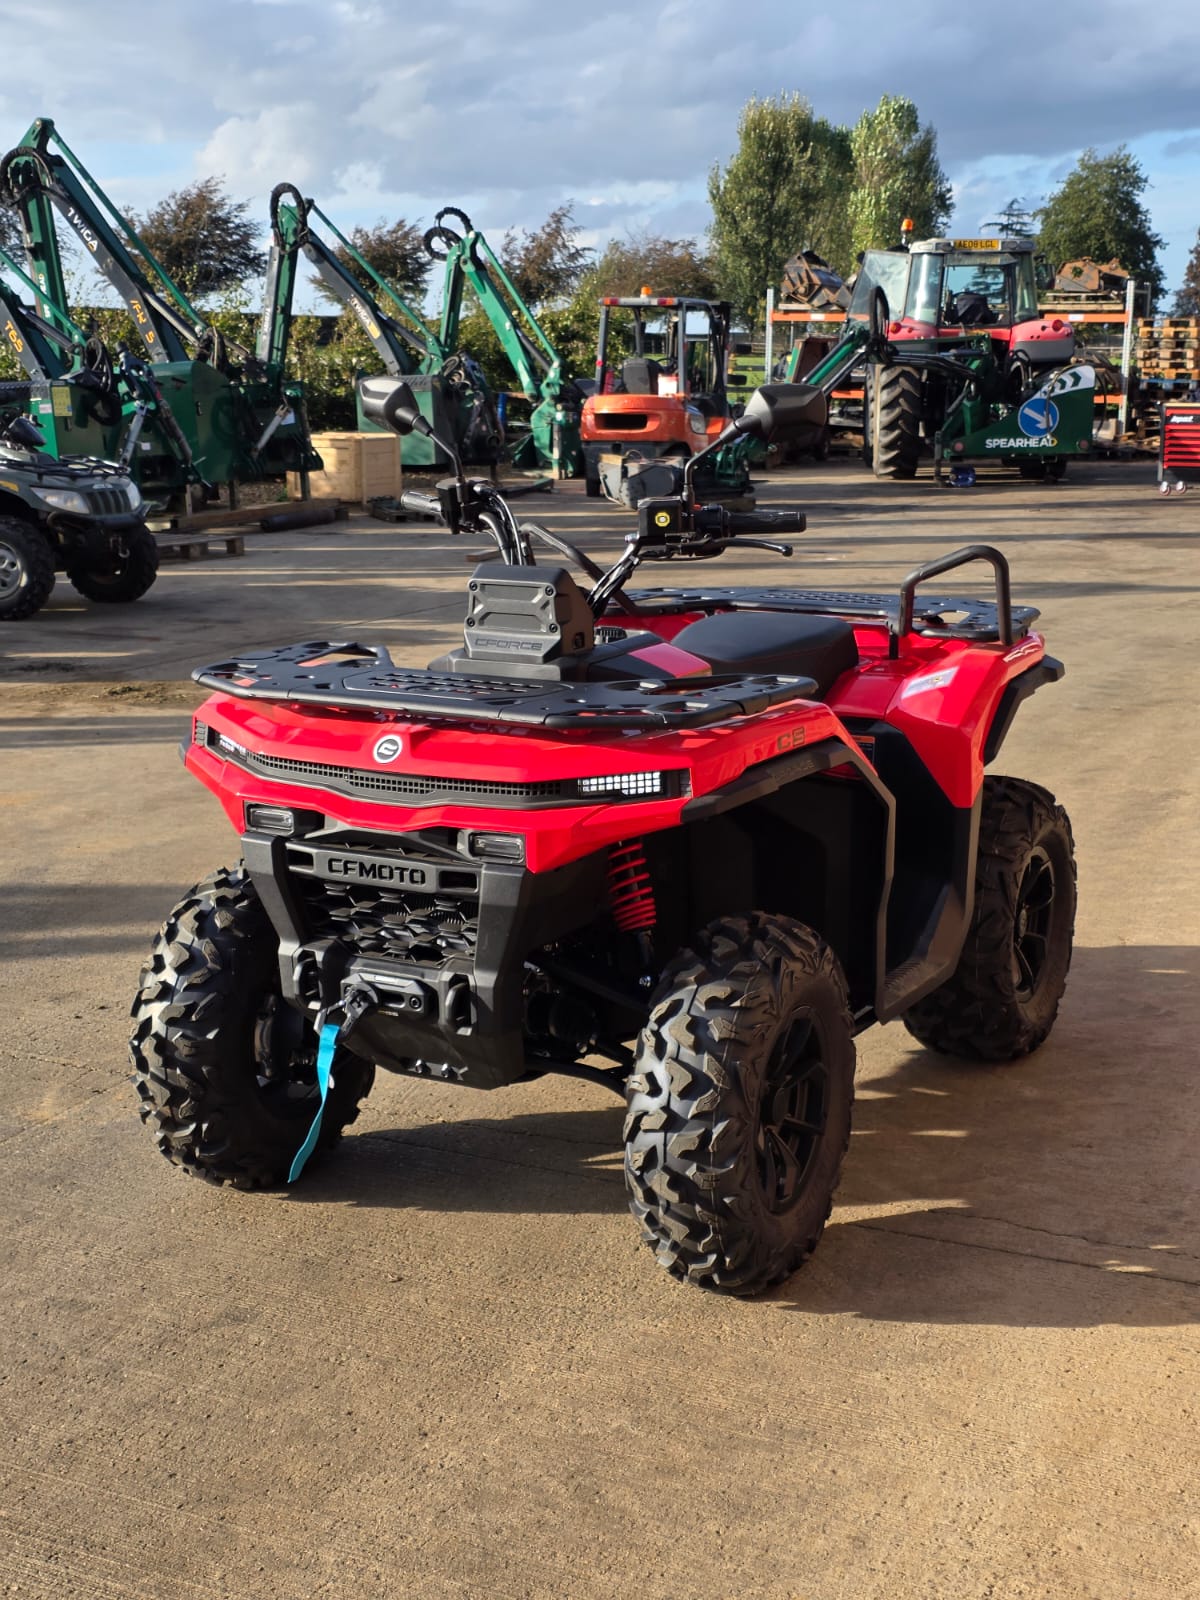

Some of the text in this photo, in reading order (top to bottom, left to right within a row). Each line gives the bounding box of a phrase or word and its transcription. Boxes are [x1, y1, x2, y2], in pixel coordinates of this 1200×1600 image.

[67, 207, 98, 252] TWIGA
[985, 438, 1058, 448] SPEARHEAD
[475, 638, 543, 650] CFORCE
[327, 858, 426, 885] CFMOTO
